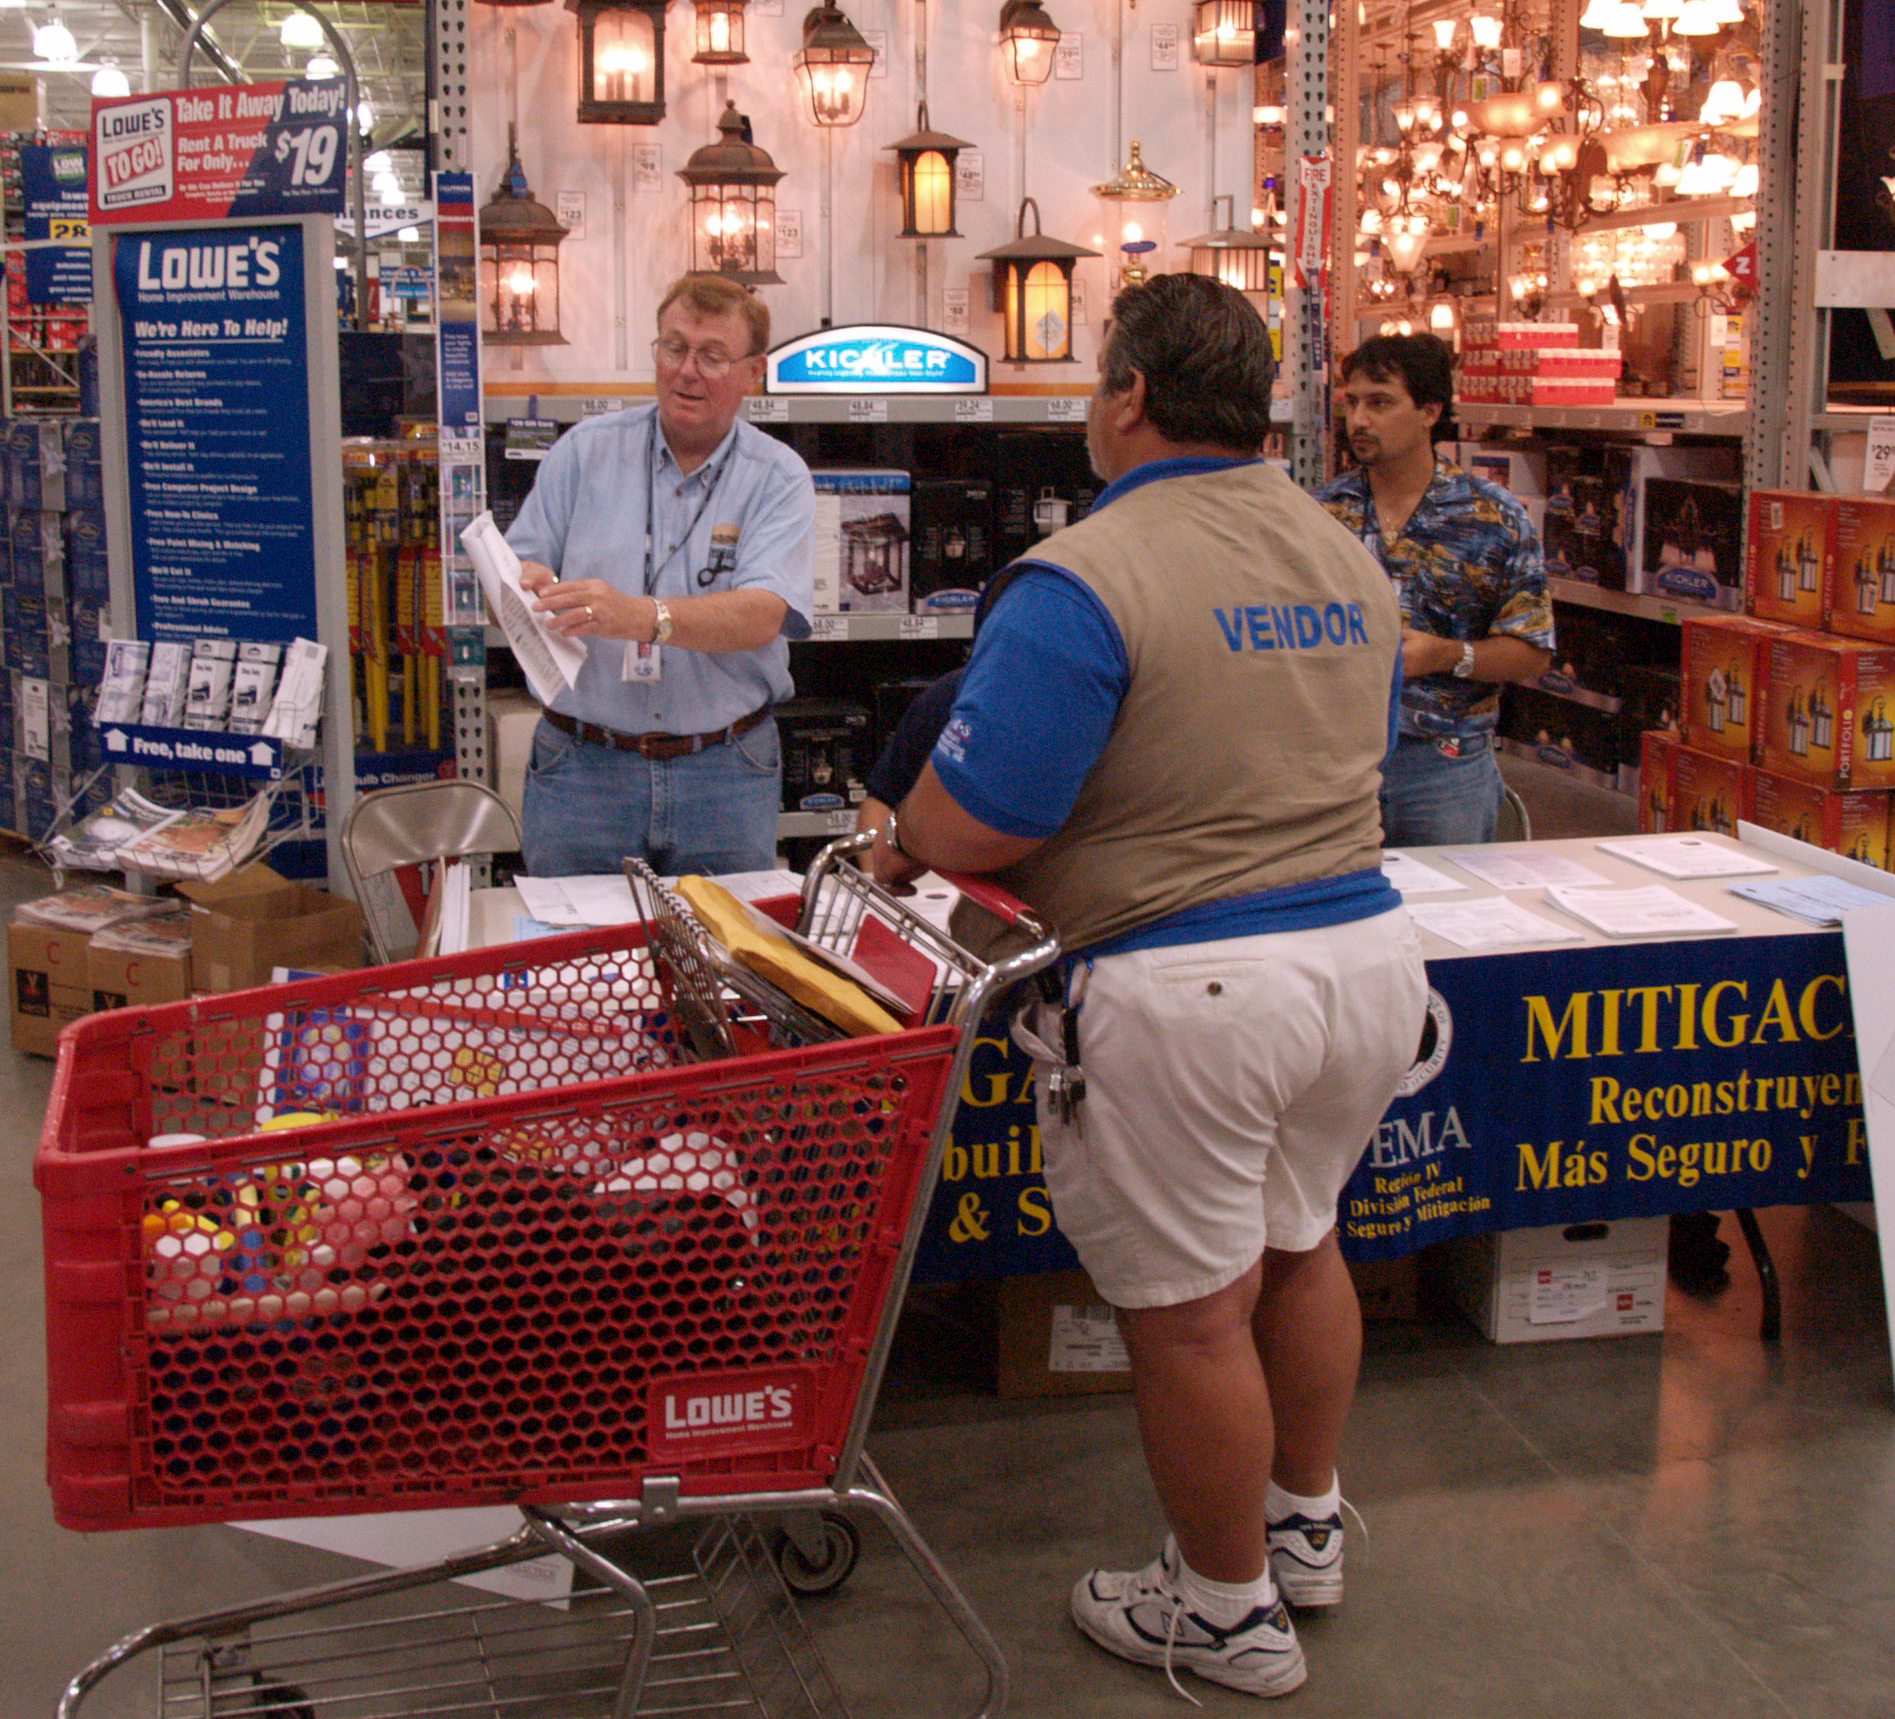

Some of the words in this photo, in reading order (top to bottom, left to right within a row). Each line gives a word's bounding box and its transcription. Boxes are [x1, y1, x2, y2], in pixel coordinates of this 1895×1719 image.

[102, 107, 165, 138] LOWE'S
[176, 97, 214, 123] Take
[218, 93, 232, 119] It
[236, 91, 285, 122] Away
[288, 83, 346, 118] Today!
[107, 150, 128, 183] TO
[131, 138, 164, 175] GO!
[177, 137, 210, 154] Rent
[213, 134, 225, 151] A
[228, 132, 268, 150] Truck
[274, 125, 339, 186] $19
[177, 155, 201, 172] For
[1304, 167, 1327, 182] FIRE
[105, 191, 133, 204] TRUCK
[1305, 181, 1318, 271] EXTINGUISHE
[138, 236, 281, 290] LOWE'S
[138, 291, 165, 303] Home
[166, 290, 226, 304] Improvement
[228, 289, 281, 301] Warehouse
[135, 320, 178, 338] We're
[181, 319, 219, 337] Here
[223, 318, 241, 336] To
[245, 317, 289, 339] Help!
[1212, 601, 1370, 652] VENDOR
[133, 737, 174, 761] Free,
[175, 741, 212, 761] take
[214, 748, 247, 764] one
[1838, 708, 1854, 779] PORTFOLIO
[381, 772, 436, 784] Changer
[1519, 974, 1855, 1063] MITIGAC
[1588, 1068, 1865, 1126] Reconstruyen
[942, 1124, 1044, 1182] buil
[1368, 1105, 1473, 1168] EMA
[1425, 1160, 1442, 1181] IV
[1514, 1139, 1608, 1192] Más
[1626, 1133, 1773, 1188] Seguro
[1796, 1134, 1819, 1180] y
[1413, 1175, 1464, 1203] Federal
[1416, 1195, 1493, 1222] Mitigación
[949, 1191, 991, 1243] &
[1016, 1185, 1052, 1237] S
[665, 1384, 793, 1429] LOWE'S
[665, 1431, 691, 1440] Home
[691, 1425, 746, 1438] Improvement
[746, 1420, 793, 1431] Warehouse
